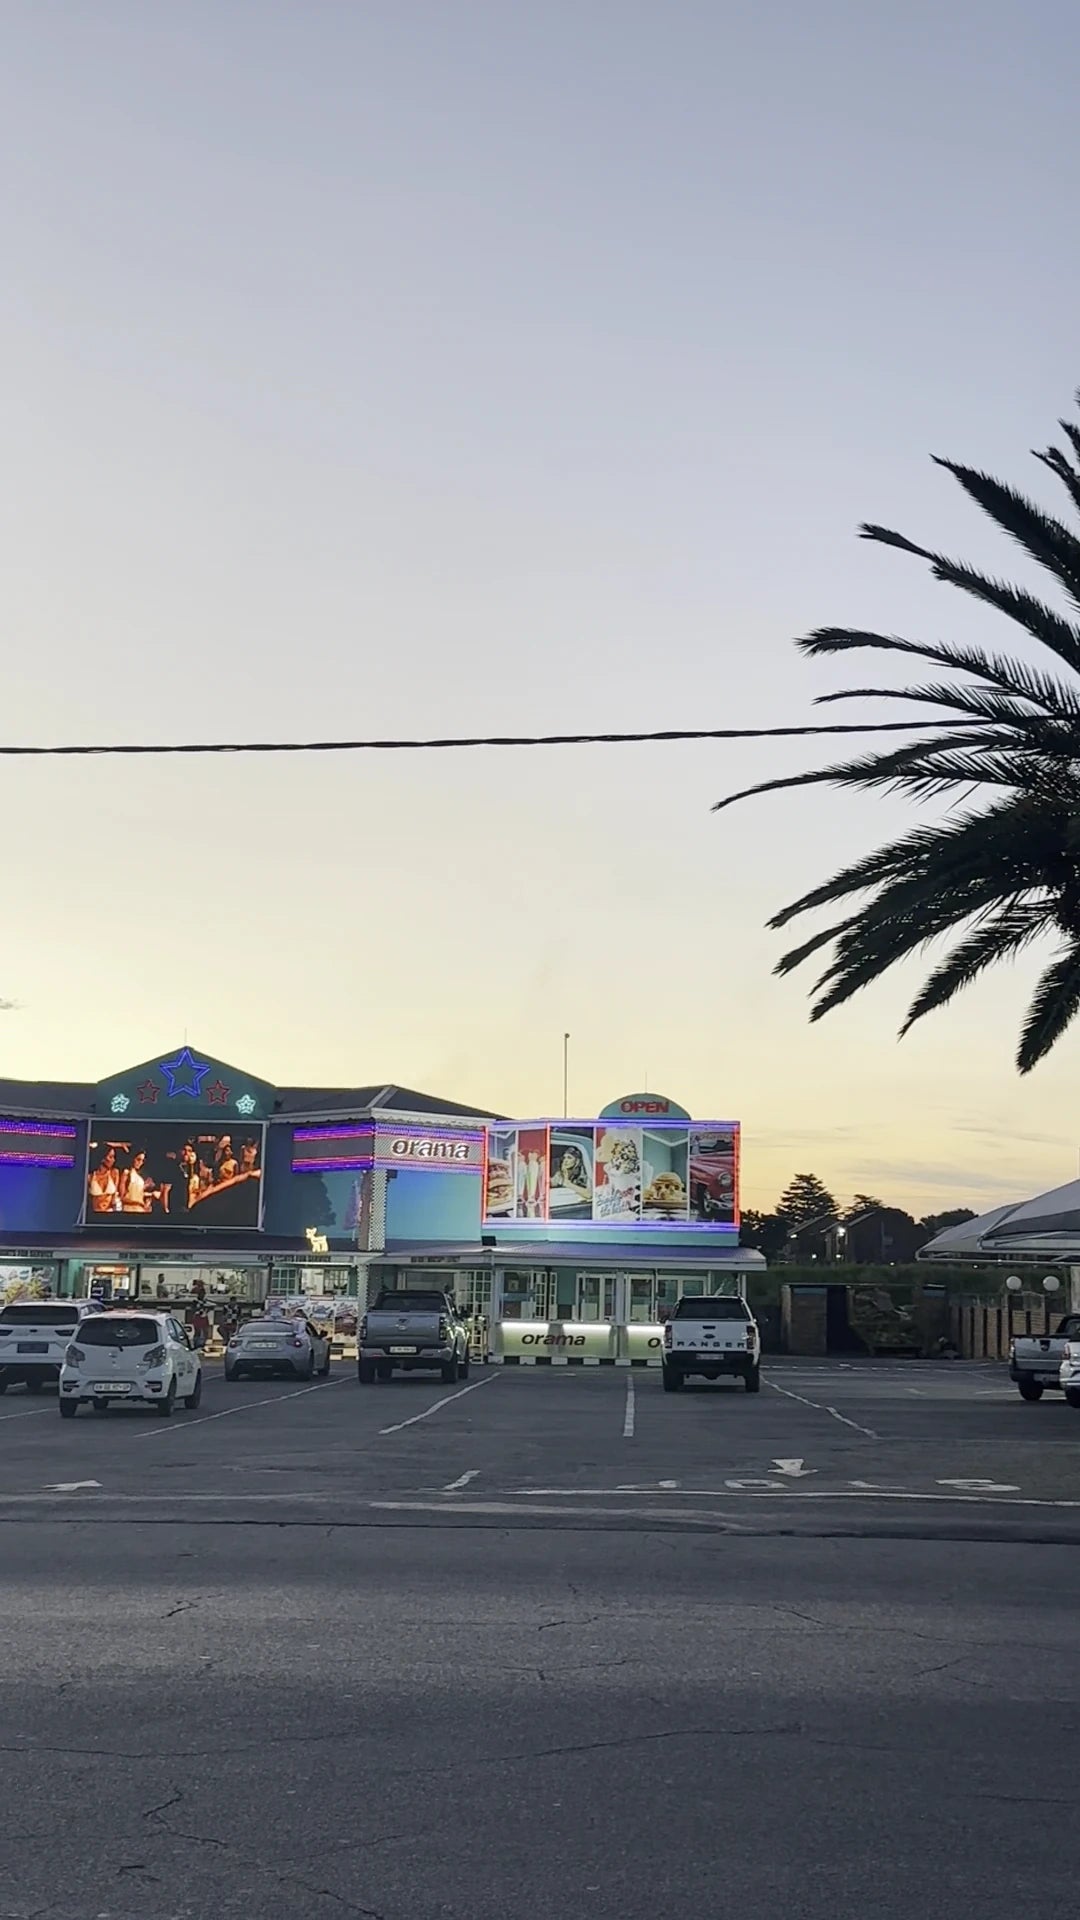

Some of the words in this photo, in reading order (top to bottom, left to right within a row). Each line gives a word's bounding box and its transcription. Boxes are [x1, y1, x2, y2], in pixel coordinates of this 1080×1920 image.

[620, 1101, 669, 1113] OPEN
[391, 1139, 470, 1160] orama
[521, 1333, 586, 1346] orama
